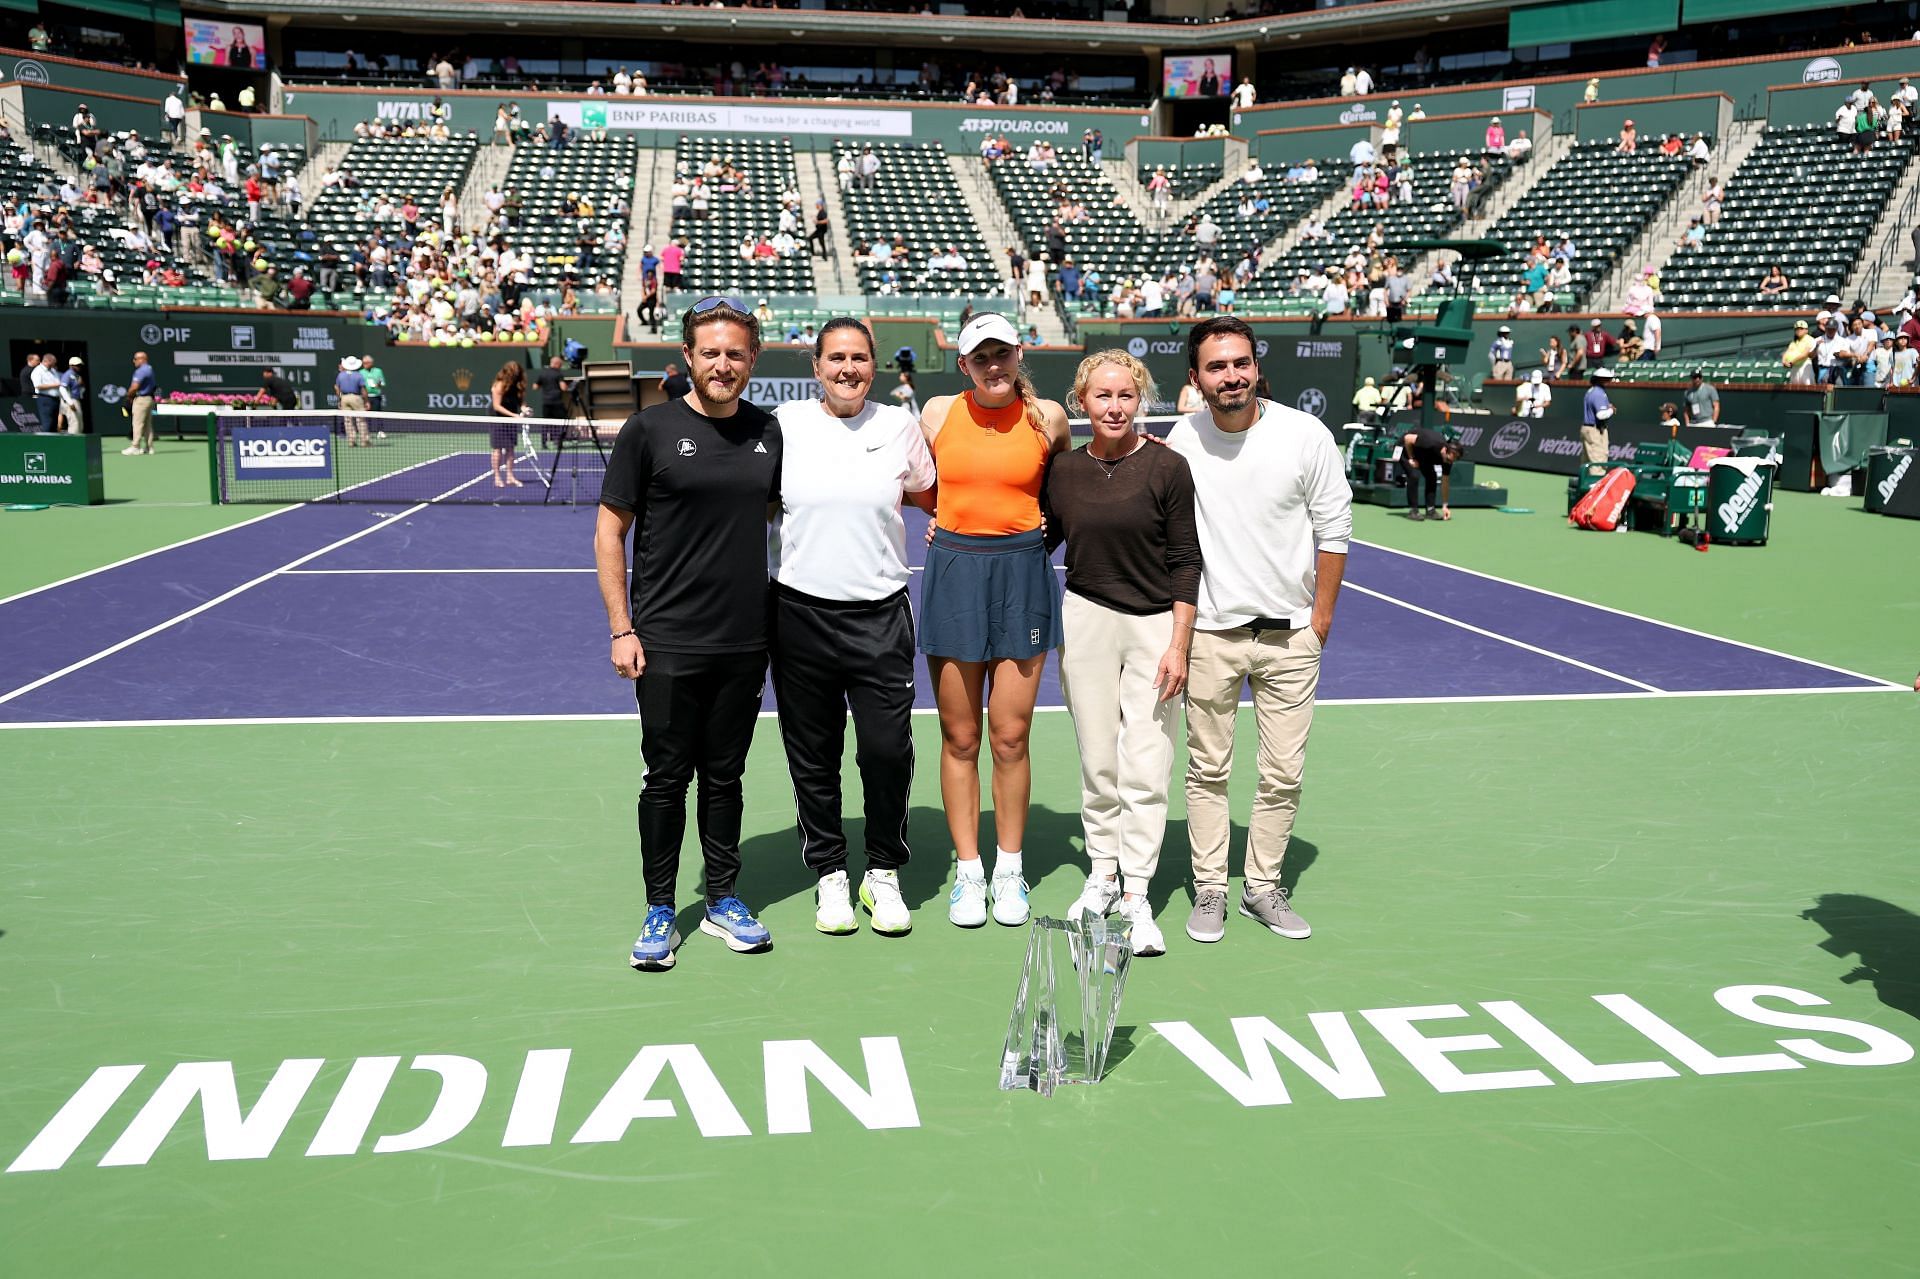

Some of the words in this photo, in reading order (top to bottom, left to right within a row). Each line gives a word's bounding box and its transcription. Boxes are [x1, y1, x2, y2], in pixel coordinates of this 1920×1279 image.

[1806, 69, 1838, 81] PEPSI
[176, 84, 185, 94] 7
[285, 94, 294, 105] 7
[377, 102, 420, 119] WTA
[421, 103, 452, 120] 100
[613, 110, 645, 122] BNP
[651, 111, 717, 124] PARIBAS
[744, 115, 760, 124] The
[763, 115, 784, 124] bank
[786, 116, 800, 127] for
[811, 117, 851, 128] changing
[855, 118, 881, 127] world
[1340, 111, 1376, 125] Corona
[163, 327, 191, 343] PIF
[298, 327, 328, 338] TENNIS
[293, 338, 334, 350] PARADISE
[1150, 341, 1184, 354] razr
[1312, 341, 1342, 351] TENNIS
[749, 381, 824, 401] PARIB
[428, 393, 492, 408] ROLEX
[239, 438, 325, 456] HOLOGIC
[1538, 435, 1584, 456] verizon
[0, 474, 24, 484] BNP
[26, 474, 72, 484] PARIBAS
[6, 1037, 920, 1172] INDIAN
[1150, 985, 1914, 1106] WELLS
